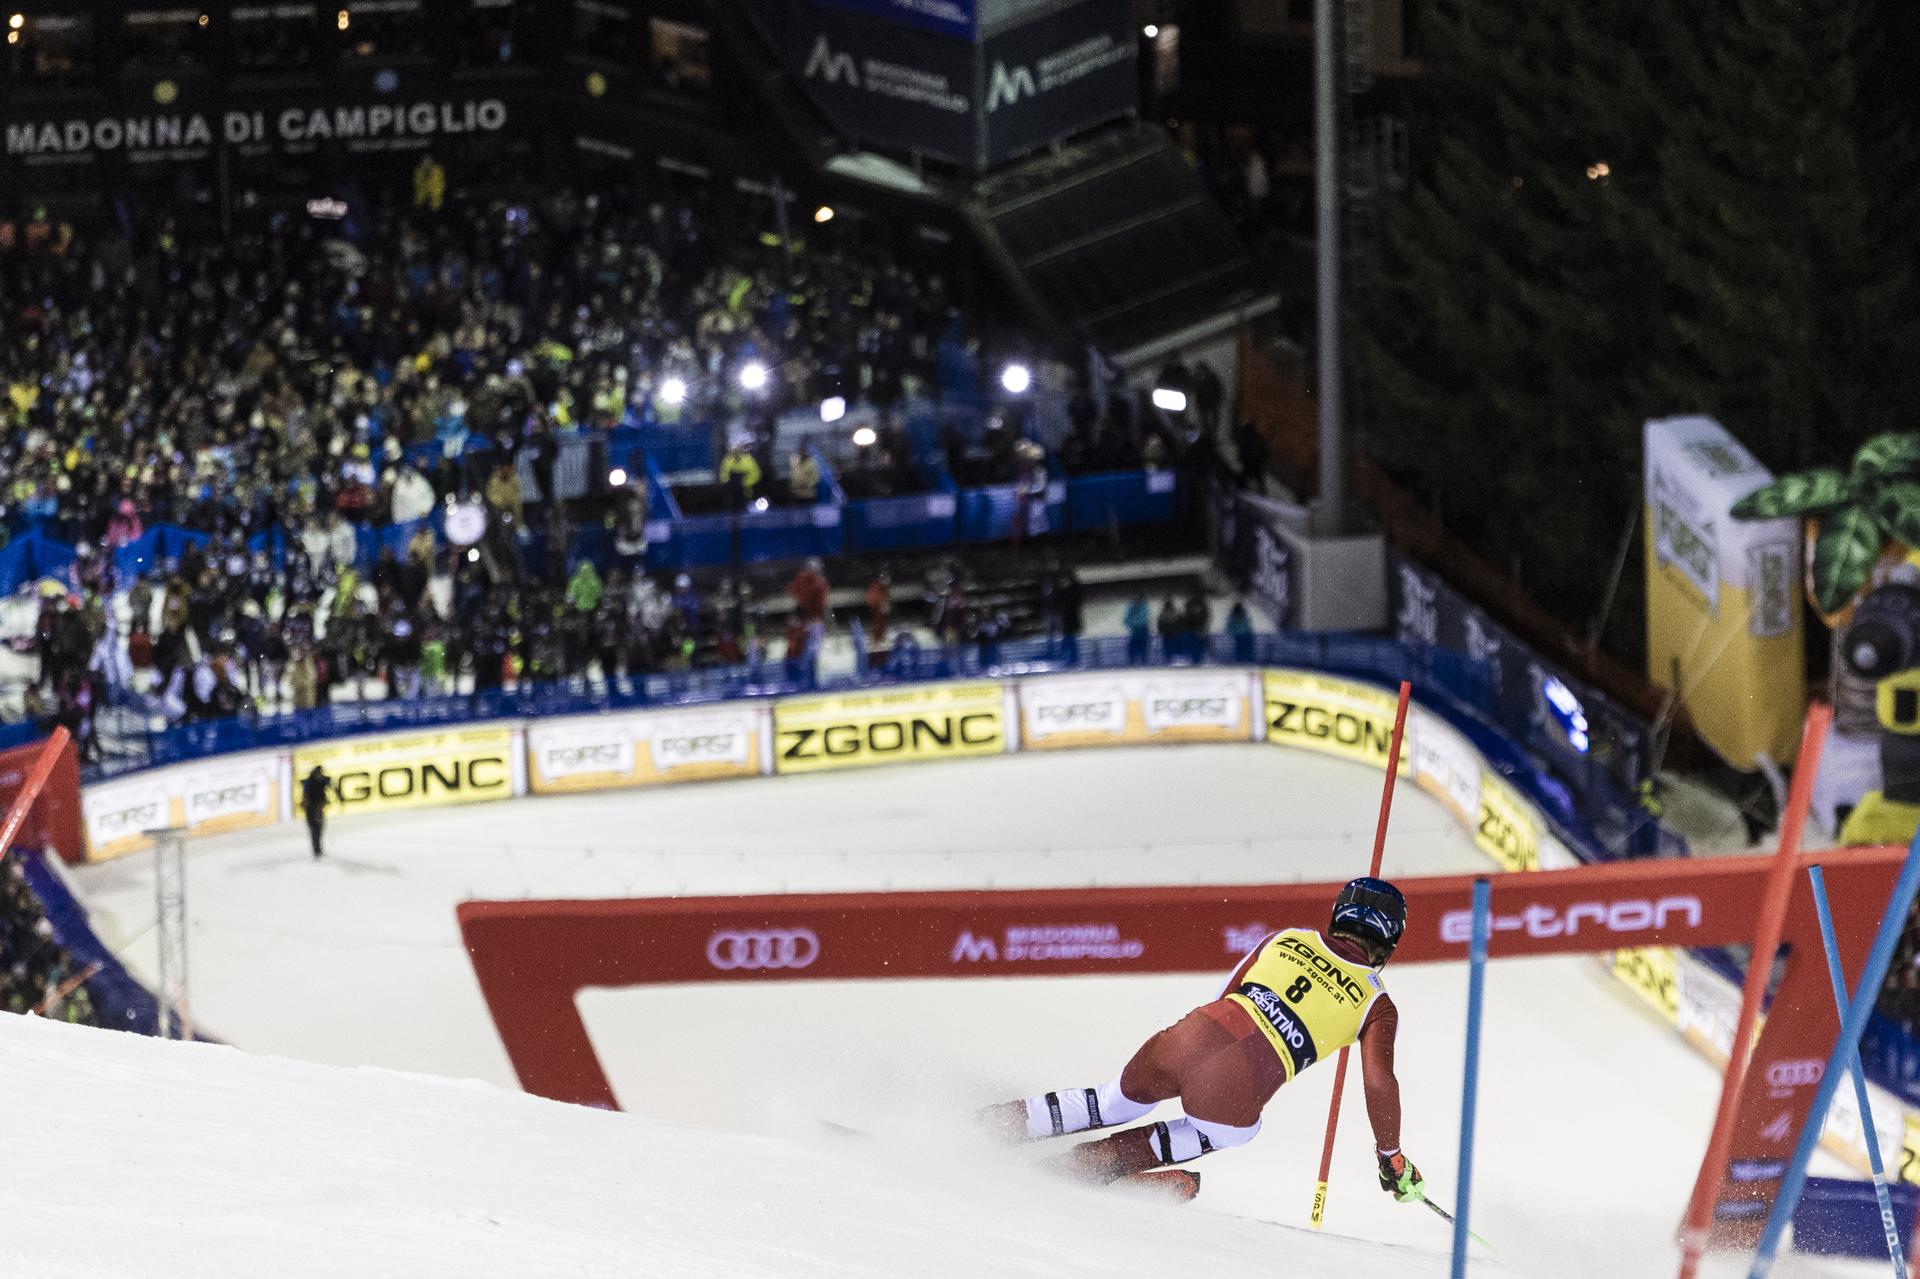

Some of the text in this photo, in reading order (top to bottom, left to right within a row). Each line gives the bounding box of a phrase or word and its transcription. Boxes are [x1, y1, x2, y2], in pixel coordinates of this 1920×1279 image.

[7, 99, 508, 152] MADONNA DI CAMPIGLIO
[782, 713, 999, 759] ZGONC
[1266, 700, 1408, 763] ZGON
[324, 757, 504, 806] GONC
[1276, 937, 1364, 1004] ZGONC
[1279, 950, 1345, 1005] www.zgonc.at
[1285, 975, 1313, 1005] 8
[1247, 985, 1305, 1049] TRENTINO
